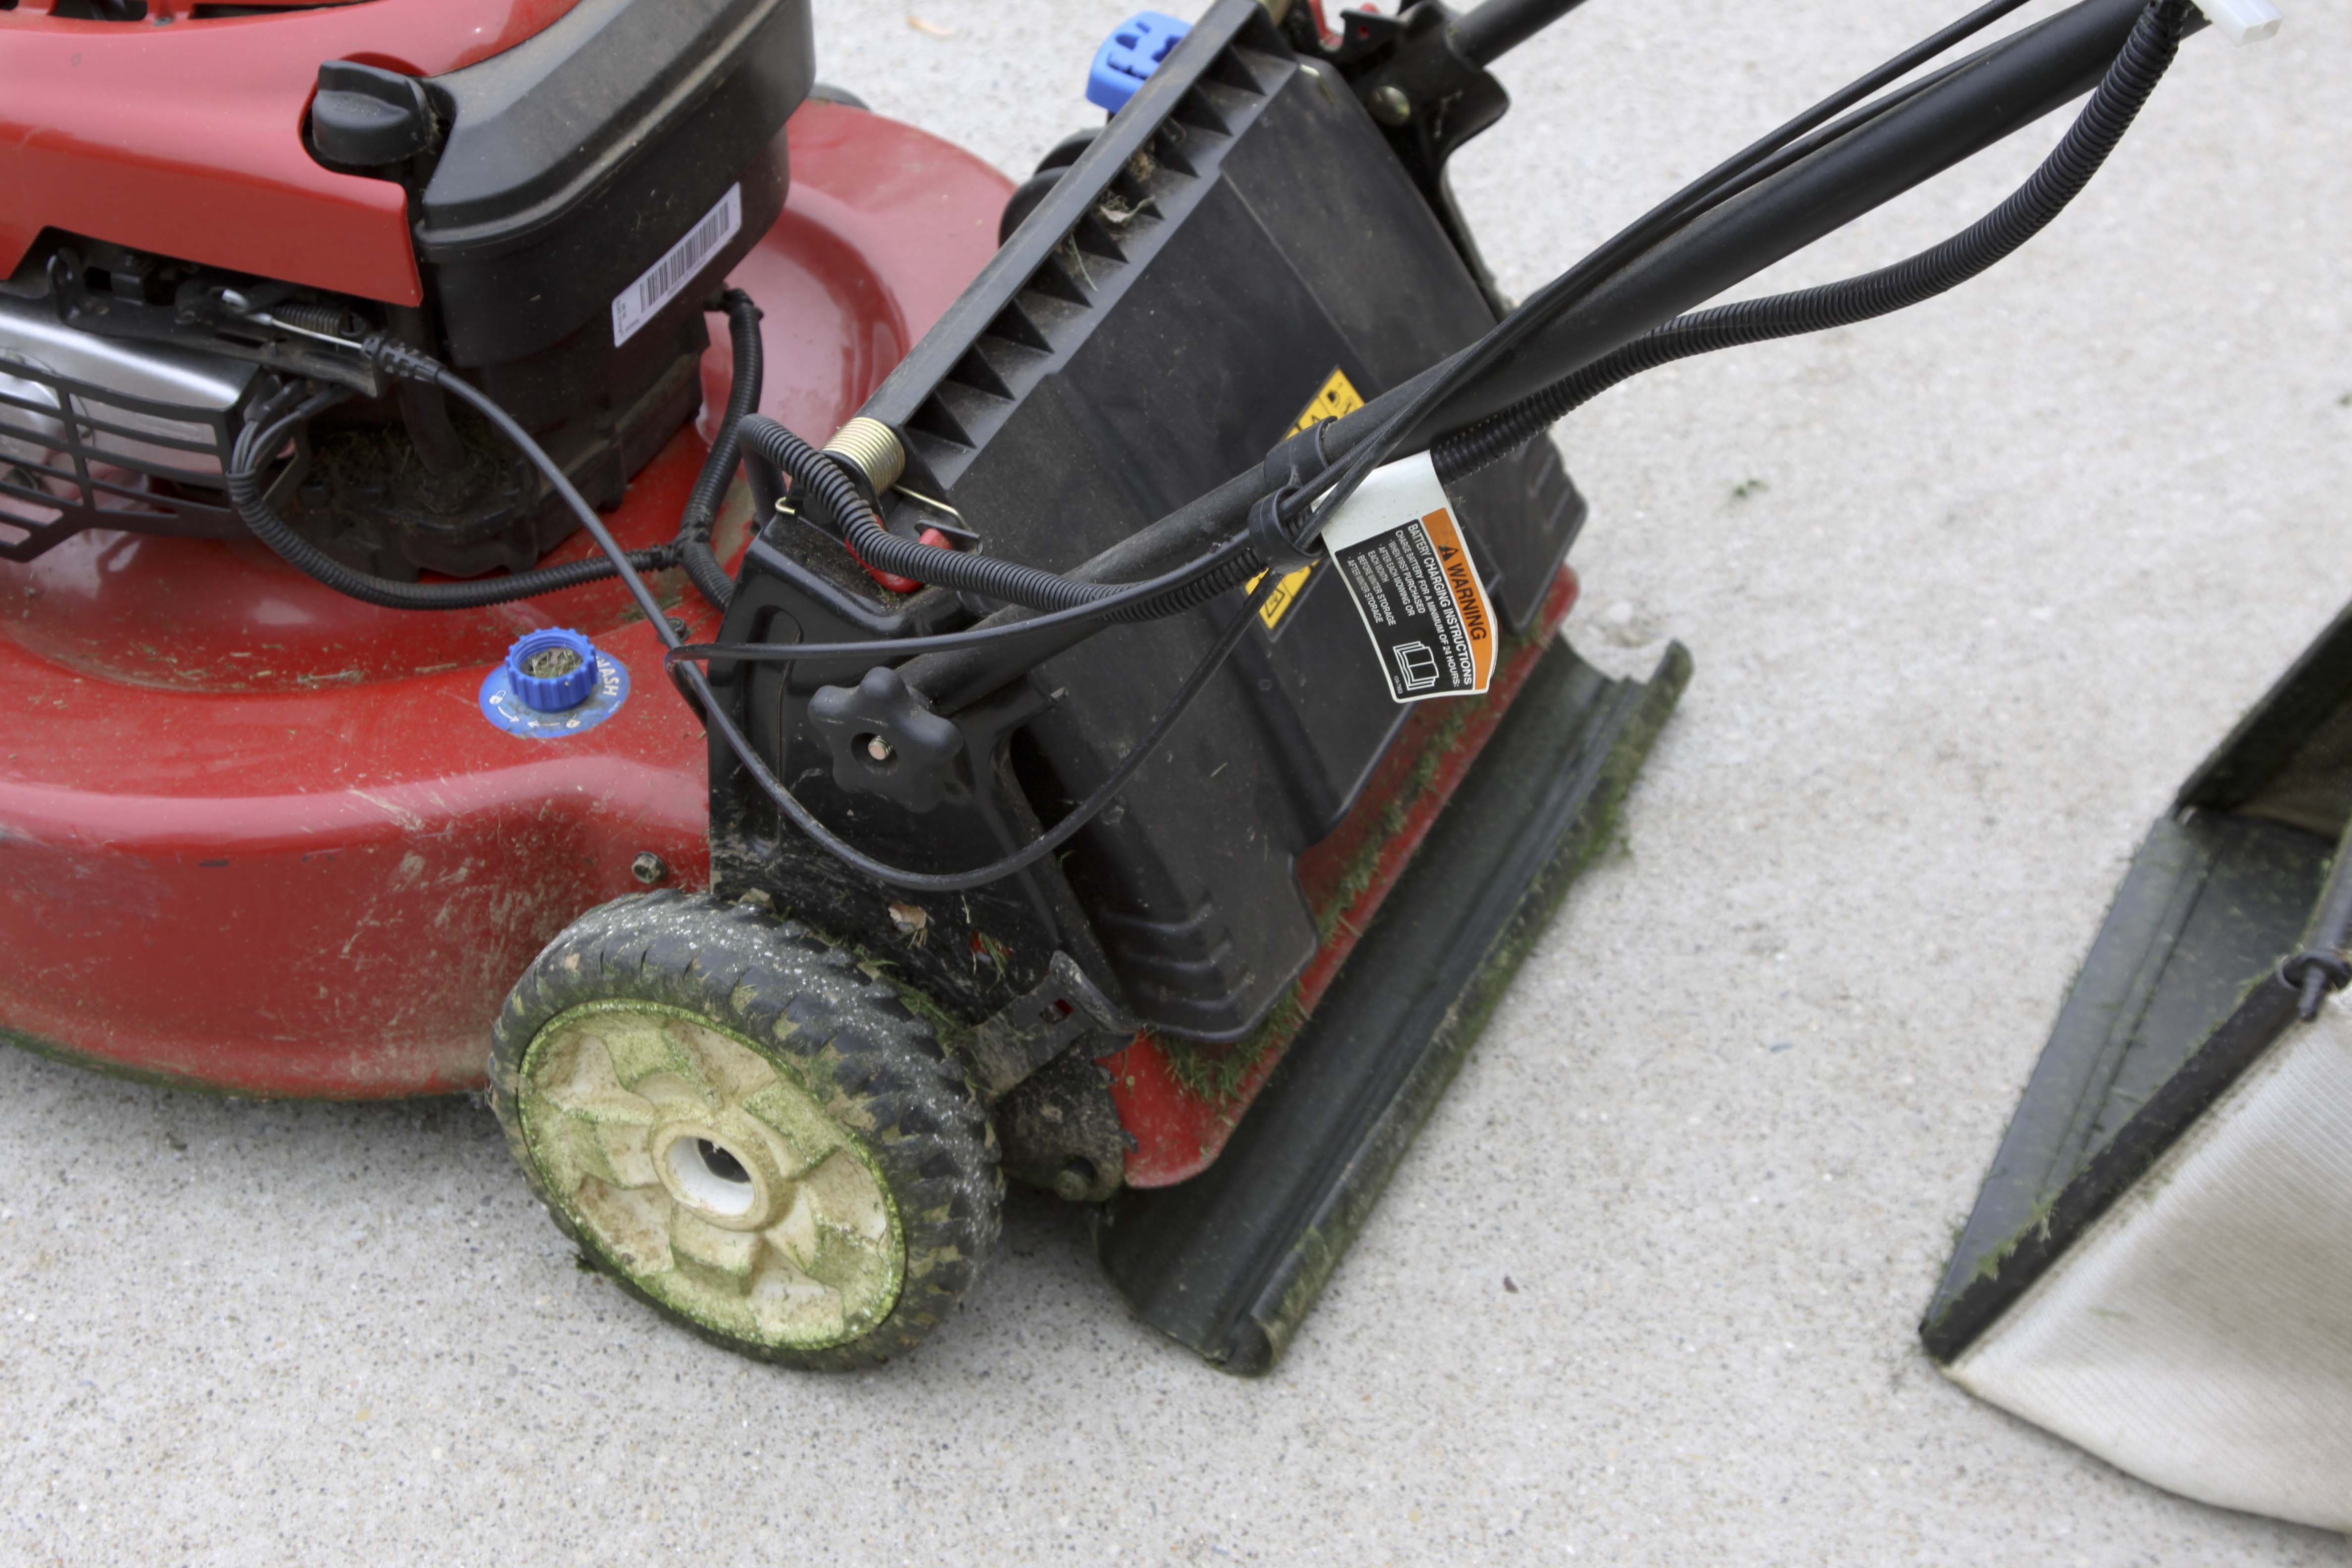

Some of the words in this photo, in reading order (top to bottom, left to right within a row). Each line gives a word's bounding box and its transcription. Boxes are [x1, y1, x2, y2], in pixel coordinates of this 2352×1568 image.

[1395, 530, 1412, 553] CHARGE
[1368, 550, 1380, 565] EACH
[1375, 564, 1389, 582] MONTH
[1378, 546, 1391, 563] AFTER
[1386, 562, 1398, 577] EACH
[1393, 576, 1410, 604] MOWING
[1405, 605, 1415, 616] OR
[1388, 540, 1400, 557] WHEN
[1396, 556, 1409, 571] FIRST
[1403, 571, 1425, 613] PURCHASED
[1406, 552, 1423, 578] BATTERY
[1347, 560, 1361, 576] AFTER
[1356, 575, 1370, 593] WINTER
[1365, 592, 1383, 623] STORAGE
[1357, 554, 1372, 576] BEFORE
[1368, 574, 1382, 594] WINTER
[1377, 593, 1396, 626] STORAGE
[1418, 580, 1429, 594] FOR
[1447, 563, 1486, 639] WARNING
[1408, 523, 1431, 555] BATTERY
[1423, 557, 1450, 607] CHARGING
[1443, 608, 1471, 685] INSTRUCTIONS
[1426, 601, 1444, 633] MINIMUM
[1439, 634, 1449, 644] OF
[1442, 645, 1452, 654] 24
[1446, 655, 1459, 686] HOURS:
